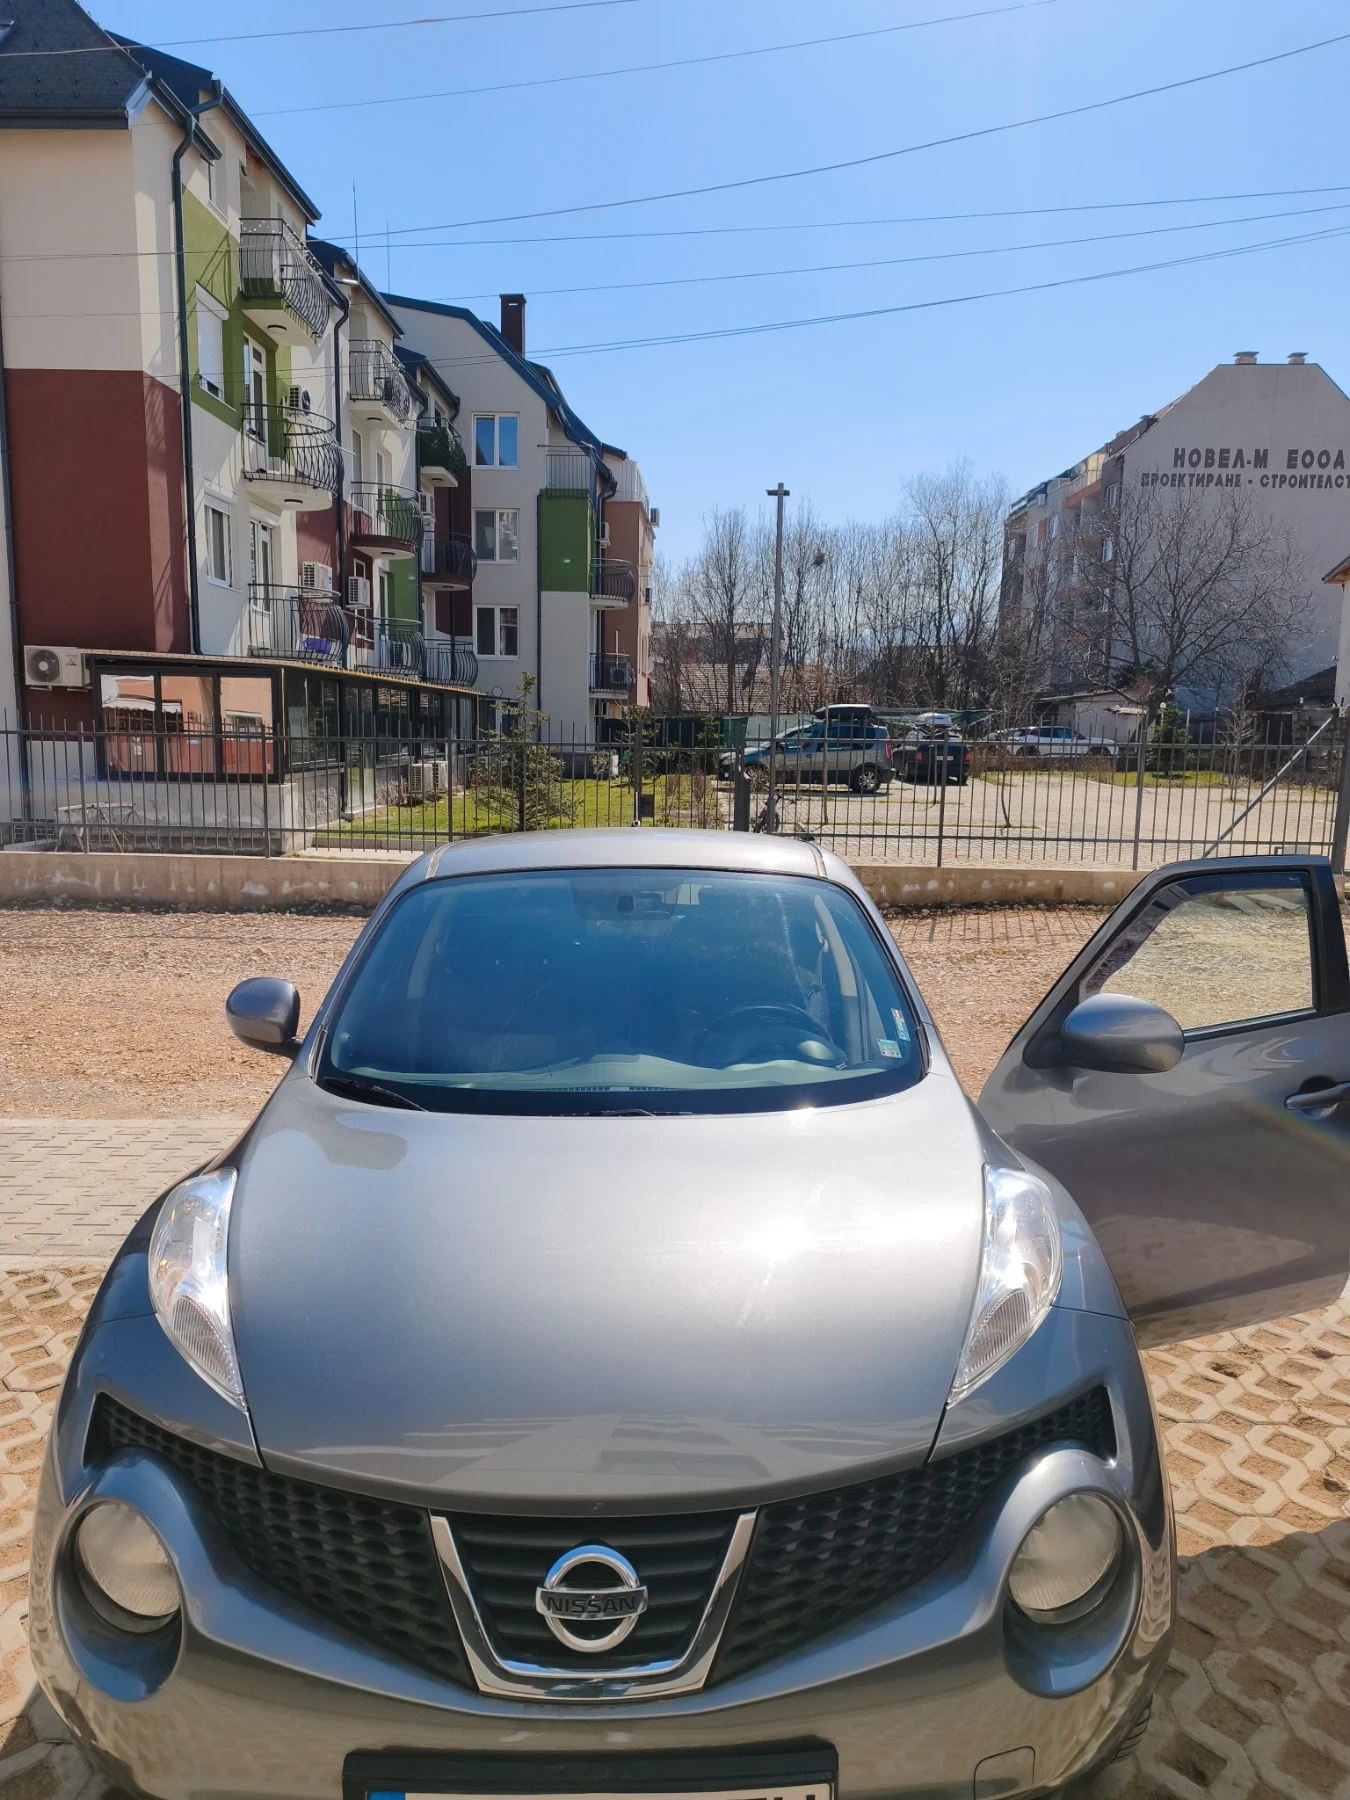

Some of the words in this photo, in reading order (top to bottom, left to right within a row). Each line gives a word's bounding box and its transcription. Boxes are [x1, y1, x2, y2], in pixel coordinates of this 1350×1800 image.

[1173, 447, 1268, 469] НОВЕЛ-М
[1140, 472, 1241, 488] ПРОЕКТИРАНЕ
[547, 1595, 636, 1614] NISSAN
